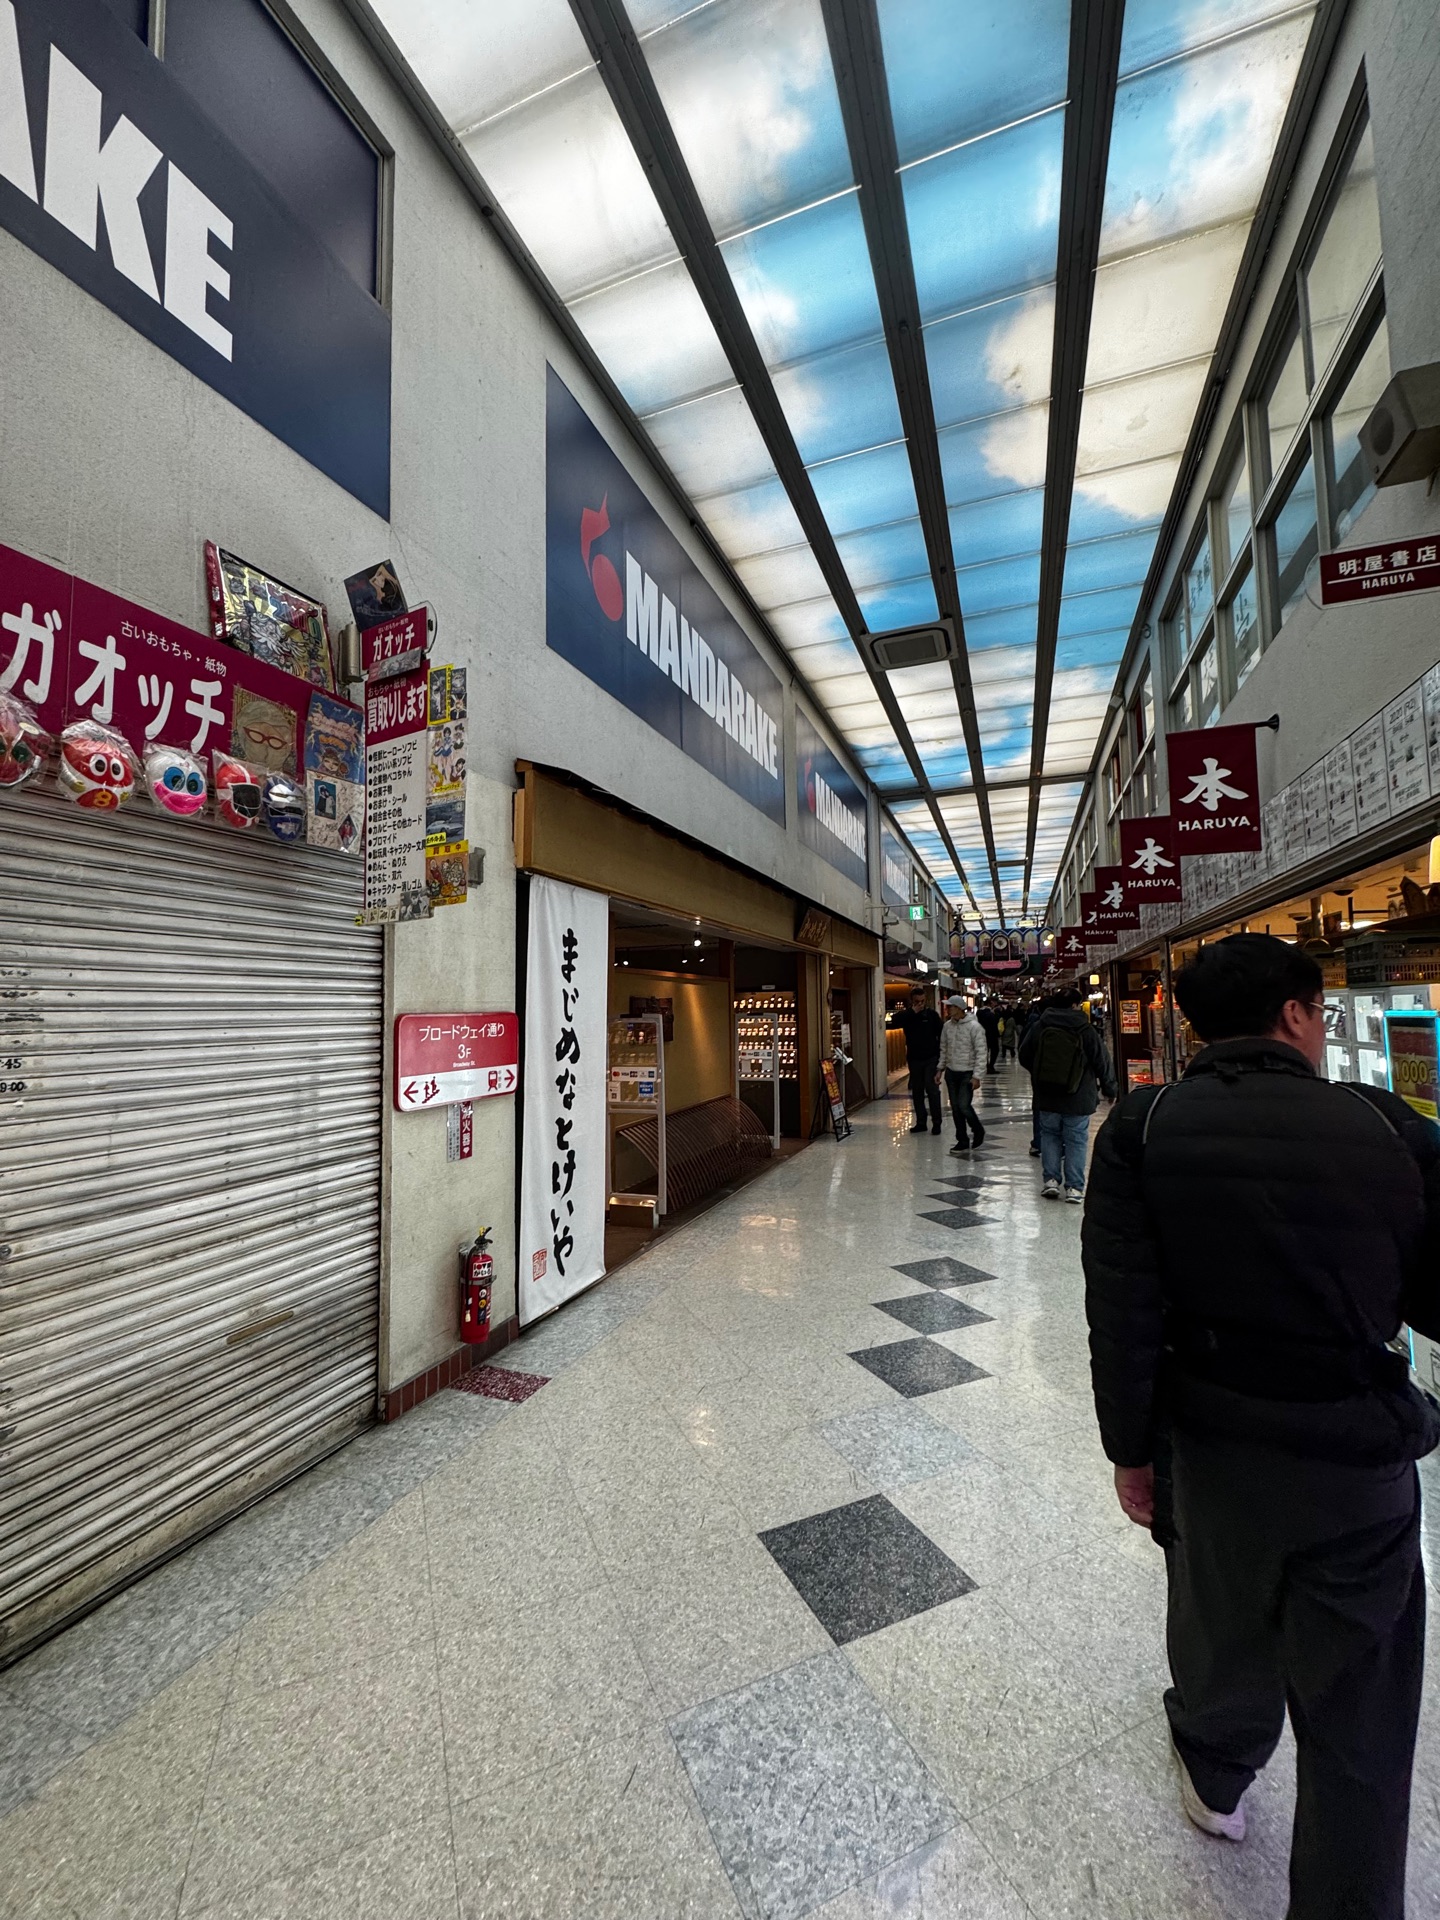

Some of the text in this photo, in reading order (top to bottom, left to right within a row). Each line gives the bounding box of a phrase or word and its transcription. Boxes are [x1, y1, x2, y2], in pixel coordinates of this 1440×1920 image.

[1338, 545, 1437, 576] 明屋書店
[1361, 572, 1416, 590] HARUYA
[120, 620, 227, 678] 古いおもちゃ・紙物
[373, 623, 415, 662] ガオッチ
[0, 602, 225, 754] ガオッチ
[626, 550, 778, 780] MANDARAKE
[367, 681, 427, 735] 買取りします
[1179, 757, 1249, 812] 本
[815, 772, 867, 863] MANDARAKE
[1178, 815, 1251, 832] HARUYA
[1129, 837, 1175, 875] 本
[1127, 878, 1176, 889] HARUYA
[1099, 911, 1135, 919] HARUYA
[1065, 935, 1084, 952] 本
[418, 1022, 505, 1042] ブロードウェイ通り
[0, 1058, 22, 1070] :45
[457, 1044, 472, 1059] 3F
[551, 928, 580, 1277] まじめなとけいや
